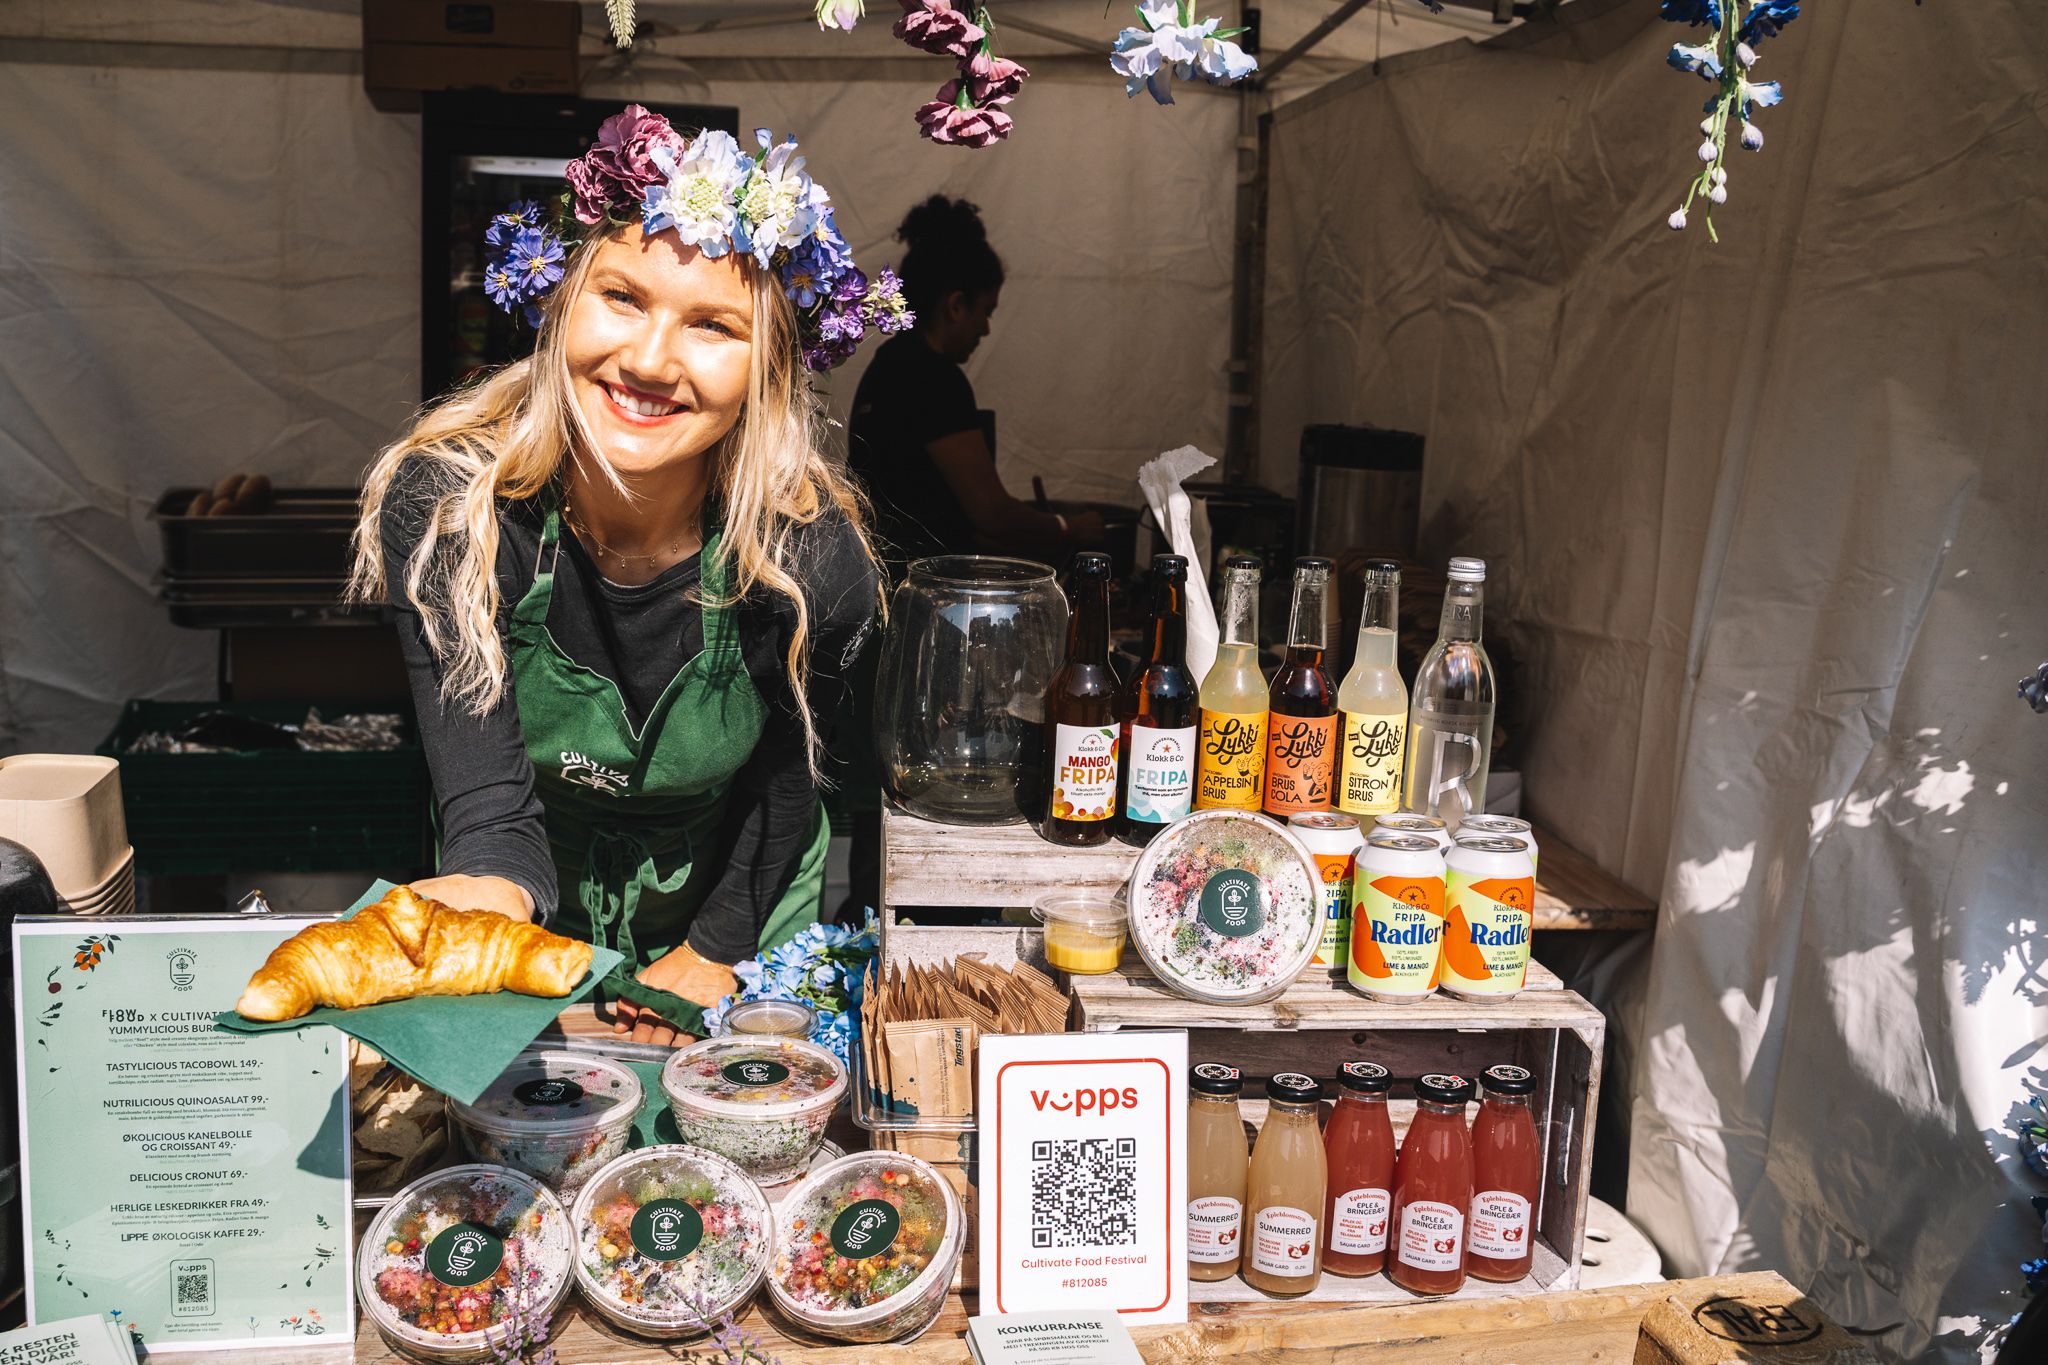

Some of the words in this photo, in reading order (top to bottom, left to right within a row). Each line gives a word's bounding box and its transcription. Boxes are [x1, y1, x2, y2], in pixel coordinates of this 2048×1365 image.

[1206, 718, 1259, 765] Lykki
[1274, 722, 1328, 768] Lykki
[1352, 720, 1403, 767] Lykki
[1068, 755, 1111, 767] MANGO
[1146, 754, 1168, 762] Klokk
[1060, 766, 1115, 784] FRIPA
[1136, 768, 1188, 785] FRIPA
[1203, 775, 1252, 788] APPELSIN
[1272, 777, 1295, 791] BRUS
[1348, 776, 1388, 789] SITRON
[1203, 786, 1226, 800] BRUS
[1271, 790, 1303, 803] COLA
[1348, 788, 1373, 802] BRUS
[1218, 879, 1251, 892] CULTIVATE
[1395, 913, 1426, 922] FRIPA
[1496, 914, 1523, 923] FRIPA
[1371, 920, 1441, 945] Radler
[166, 948, 198, 960] CULTIVATE
[109, 1025, 189, 1035] YUMMYLICIOUS
[106, 1061, 177, 1071] TASTYLICIOUS
[179, 1060, 238, 1069] TACOBOWL
[240, 1059, 264, 1068] 149,-
[103, 1098, 175, 1108] NUTRILICIOUS
[177, 1096, 249, 1107] QUINOASALAT
[251, 1095, 269, 1104] 99,-
[1029, 1087, 1138, 1117] vipps
[122, 1132, 185, 1142] ØKOLICIOUS
[188, 1130, 252, 1140] KANELBOLLE
[142, 1143, 157, 1152] OG
[160, 1141, 216, 1151] CROISSANT
[218, 1141, 237, 1150] 49,-
[129, 1173, 183, 1182] DELICIOUS
[185, 1171, 228, 1181] CRONUT
[230, 1170, 248, 1179] 69,-
[110, 1203, 152, 1212] HERLIGE
[154, 1201, 228, 1211] LESKEDRIKKER
[230, 1200, 249, 1208] FRA
[251, 1199, 270, 1207] 49,-
[1347, 1206, 1385, 1216] BRINGEBÆR
[1489, 1204, 1507, 1212] EPLE
[650, 1207, 685, 1219] CULTIVATE
[859, 1207, 887, 1223] CULTIVATE
[1189, 1212, 1239, 1223] SUMMERRED
[1421, 1214, 1438, 1223] EPLE
[1480, 1208, 1521, 1219] BRINGEBÆR
[1259, 1221, 1311, 1235] SUMMERRED
[1411, 1218, 1453, 1231] BRINGEBÆR
[121, 1233, 148, 1242] LIPPE
[152, 1231, 211, 1241] ØKOLOGISK
[213, 1229, 245, 1239] KAFFE
[247, 1228, 265, 1237] 29,-
[454, 1231, 488, 1246] CULTIVATE
[844, 1239, 862, 1250] FOOD
[178, 1264, 207, 1272] vipps
[1021, 1257, 1072, 1268] Cultivate
[1075, 1256, 1102, 1266] Food
[1105, 1255, 1147, 1265] Festival
[446, 1267, 468, 1276] FOOD
[1062, 1277, 1108, 1288] #812085
[1701, 1304, 1810, 1336] EPAL
[997, 1322, 1104, 1335] KONKURRANSE
[13, 1332, 76, 1353] RESTEN
[28, 1340, 81, 1358] DIGGE
[36, 1350, 75, 1365] VÅR!
